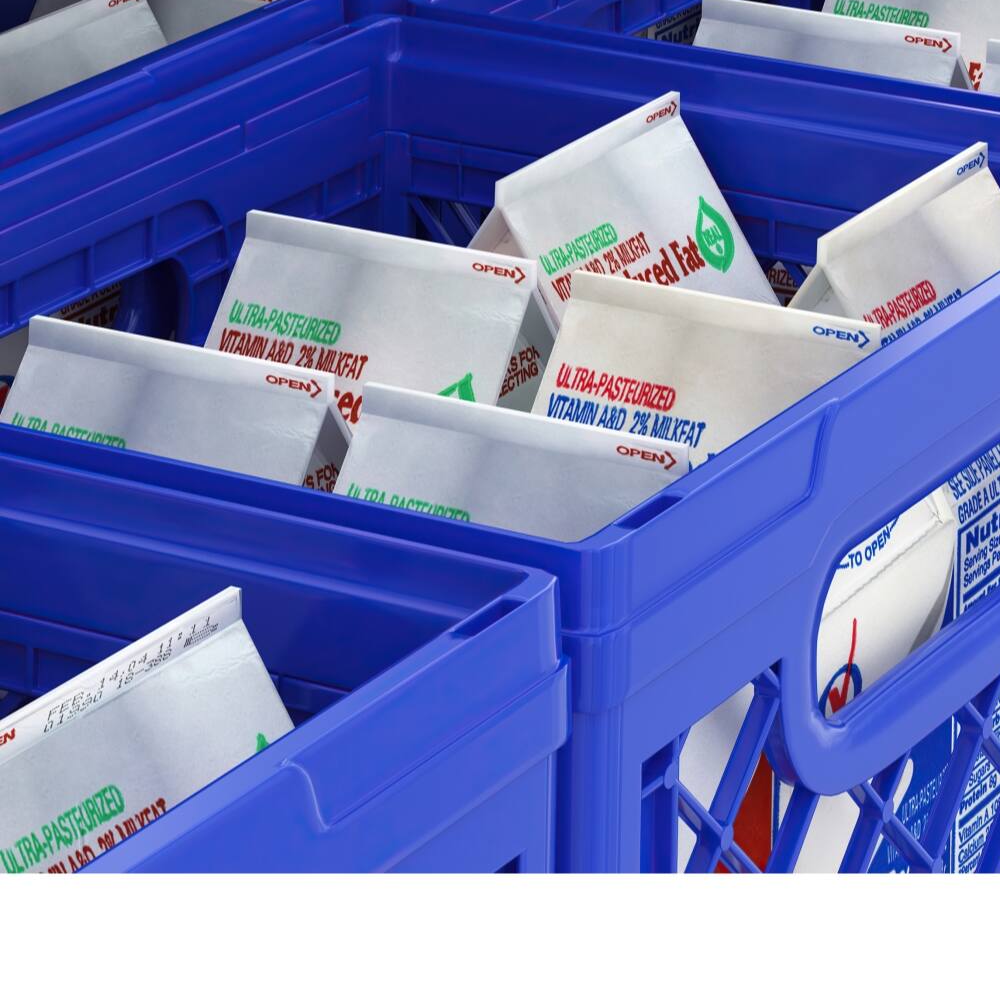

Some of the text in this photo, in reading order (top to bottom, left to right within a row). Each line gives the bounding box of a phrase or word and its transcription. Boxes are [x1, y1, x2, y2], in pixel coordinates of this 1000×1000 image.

[904, 34, 943, 49] OPEN
[646, 105, 672, 124] OPEN
[956, 157, 981, 177] OPEN
[540, 222, 619, 276] ULTRA-PASTEURIZED
[615, 231, 651, 268] MILKFAT
[668, 235, 706, 276] Fat
[472, 262, 516, 279] OPEN
[228, 299, 342, 346] ULTRA-PASTEURIZED
[812, 325, 859, 343] OPEN
[219, 328, 368, 381] VITAMIN A&D 2% MILKFAT
[265, 375, 312, 393] OPEN
[499, 362, 539, 398] ECTING
[556, 363, 677, 412] ULTRA-PASTEURIZED
[547, 393, 707, 449] VITAMIN A&D 2% MILKFAT
[616, 445, 665, 464] OPEN
[958, 491, 983, 524] GRADE
[983, 488, 989, 505] A
[848, 525, 890, 569] TO OPEN
[963, 546, 987, 572] Serving
[963, 559, 991, 588] Servings
[969, 759, 991, 787] Sugars
[959, 781, 987, 815] Protein
[0, 784, 126, 873] ULTRA-PASTEURIZED
[958, 813, 983, 844] Vitamin
[983, 808, 989, 821] A
[958, 831, 985, 863] Calcium
